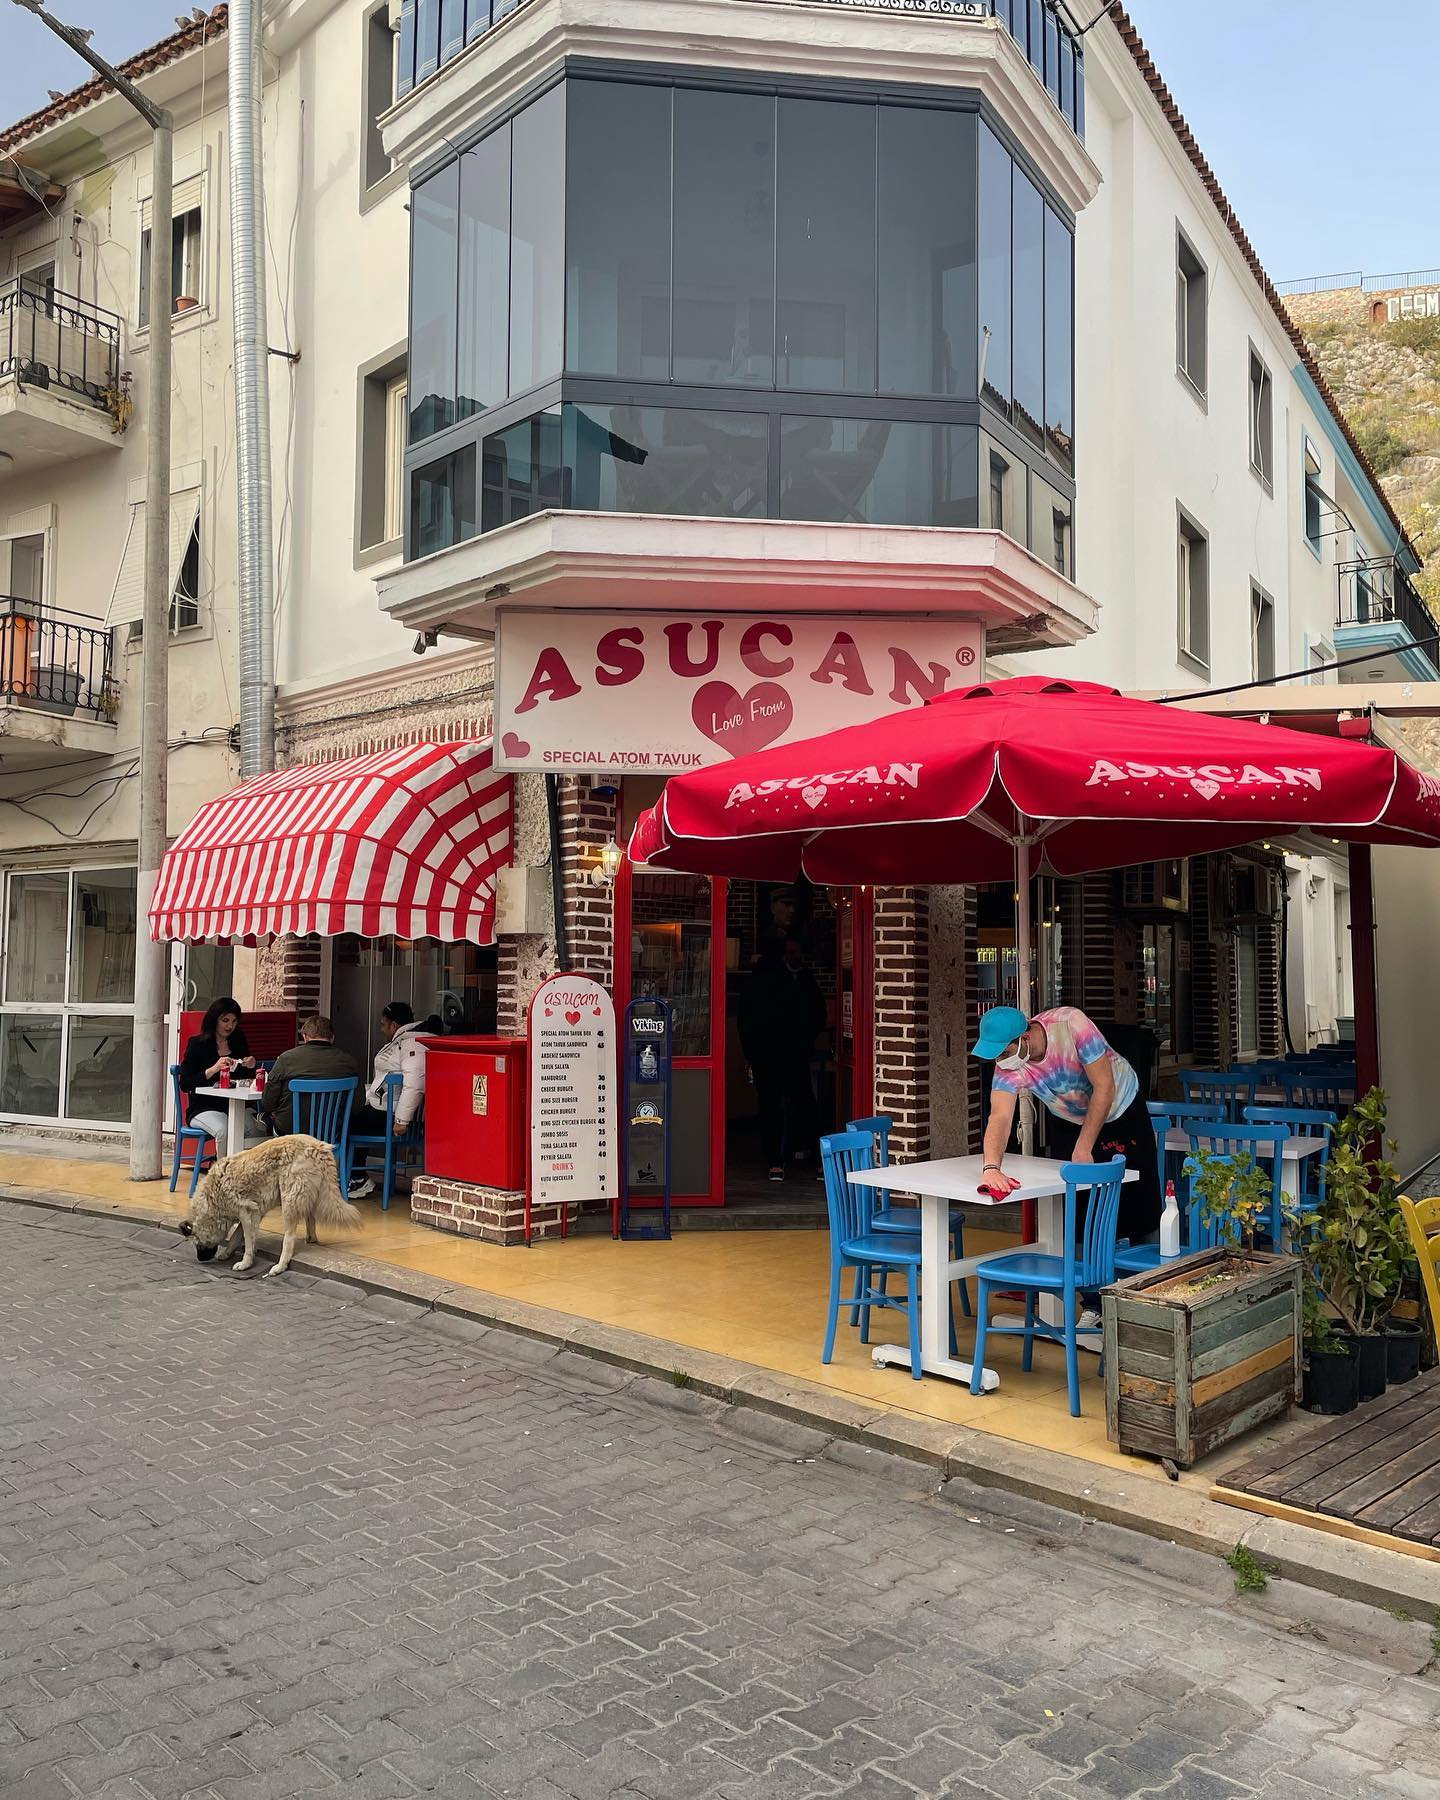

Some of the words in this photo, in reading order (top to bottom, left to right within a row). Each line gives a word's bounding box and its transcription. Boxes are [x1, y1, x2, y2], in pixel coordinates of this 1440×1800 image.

[514, 621, 951, 715] ASUCAN
[712, 712, 743, 734] Love
[750, 698, 786, 722] From
[543, 749, 606, 765] SPECIAL
[608, 751, 651, 766] ATOM
[653, 752, 703, 767] TAVUK
[724, 762, 923, 809] ASUCAN
[1085, 759, 1321, 792] ASUCAN
[632, 1018, 664, 1033] Viking
